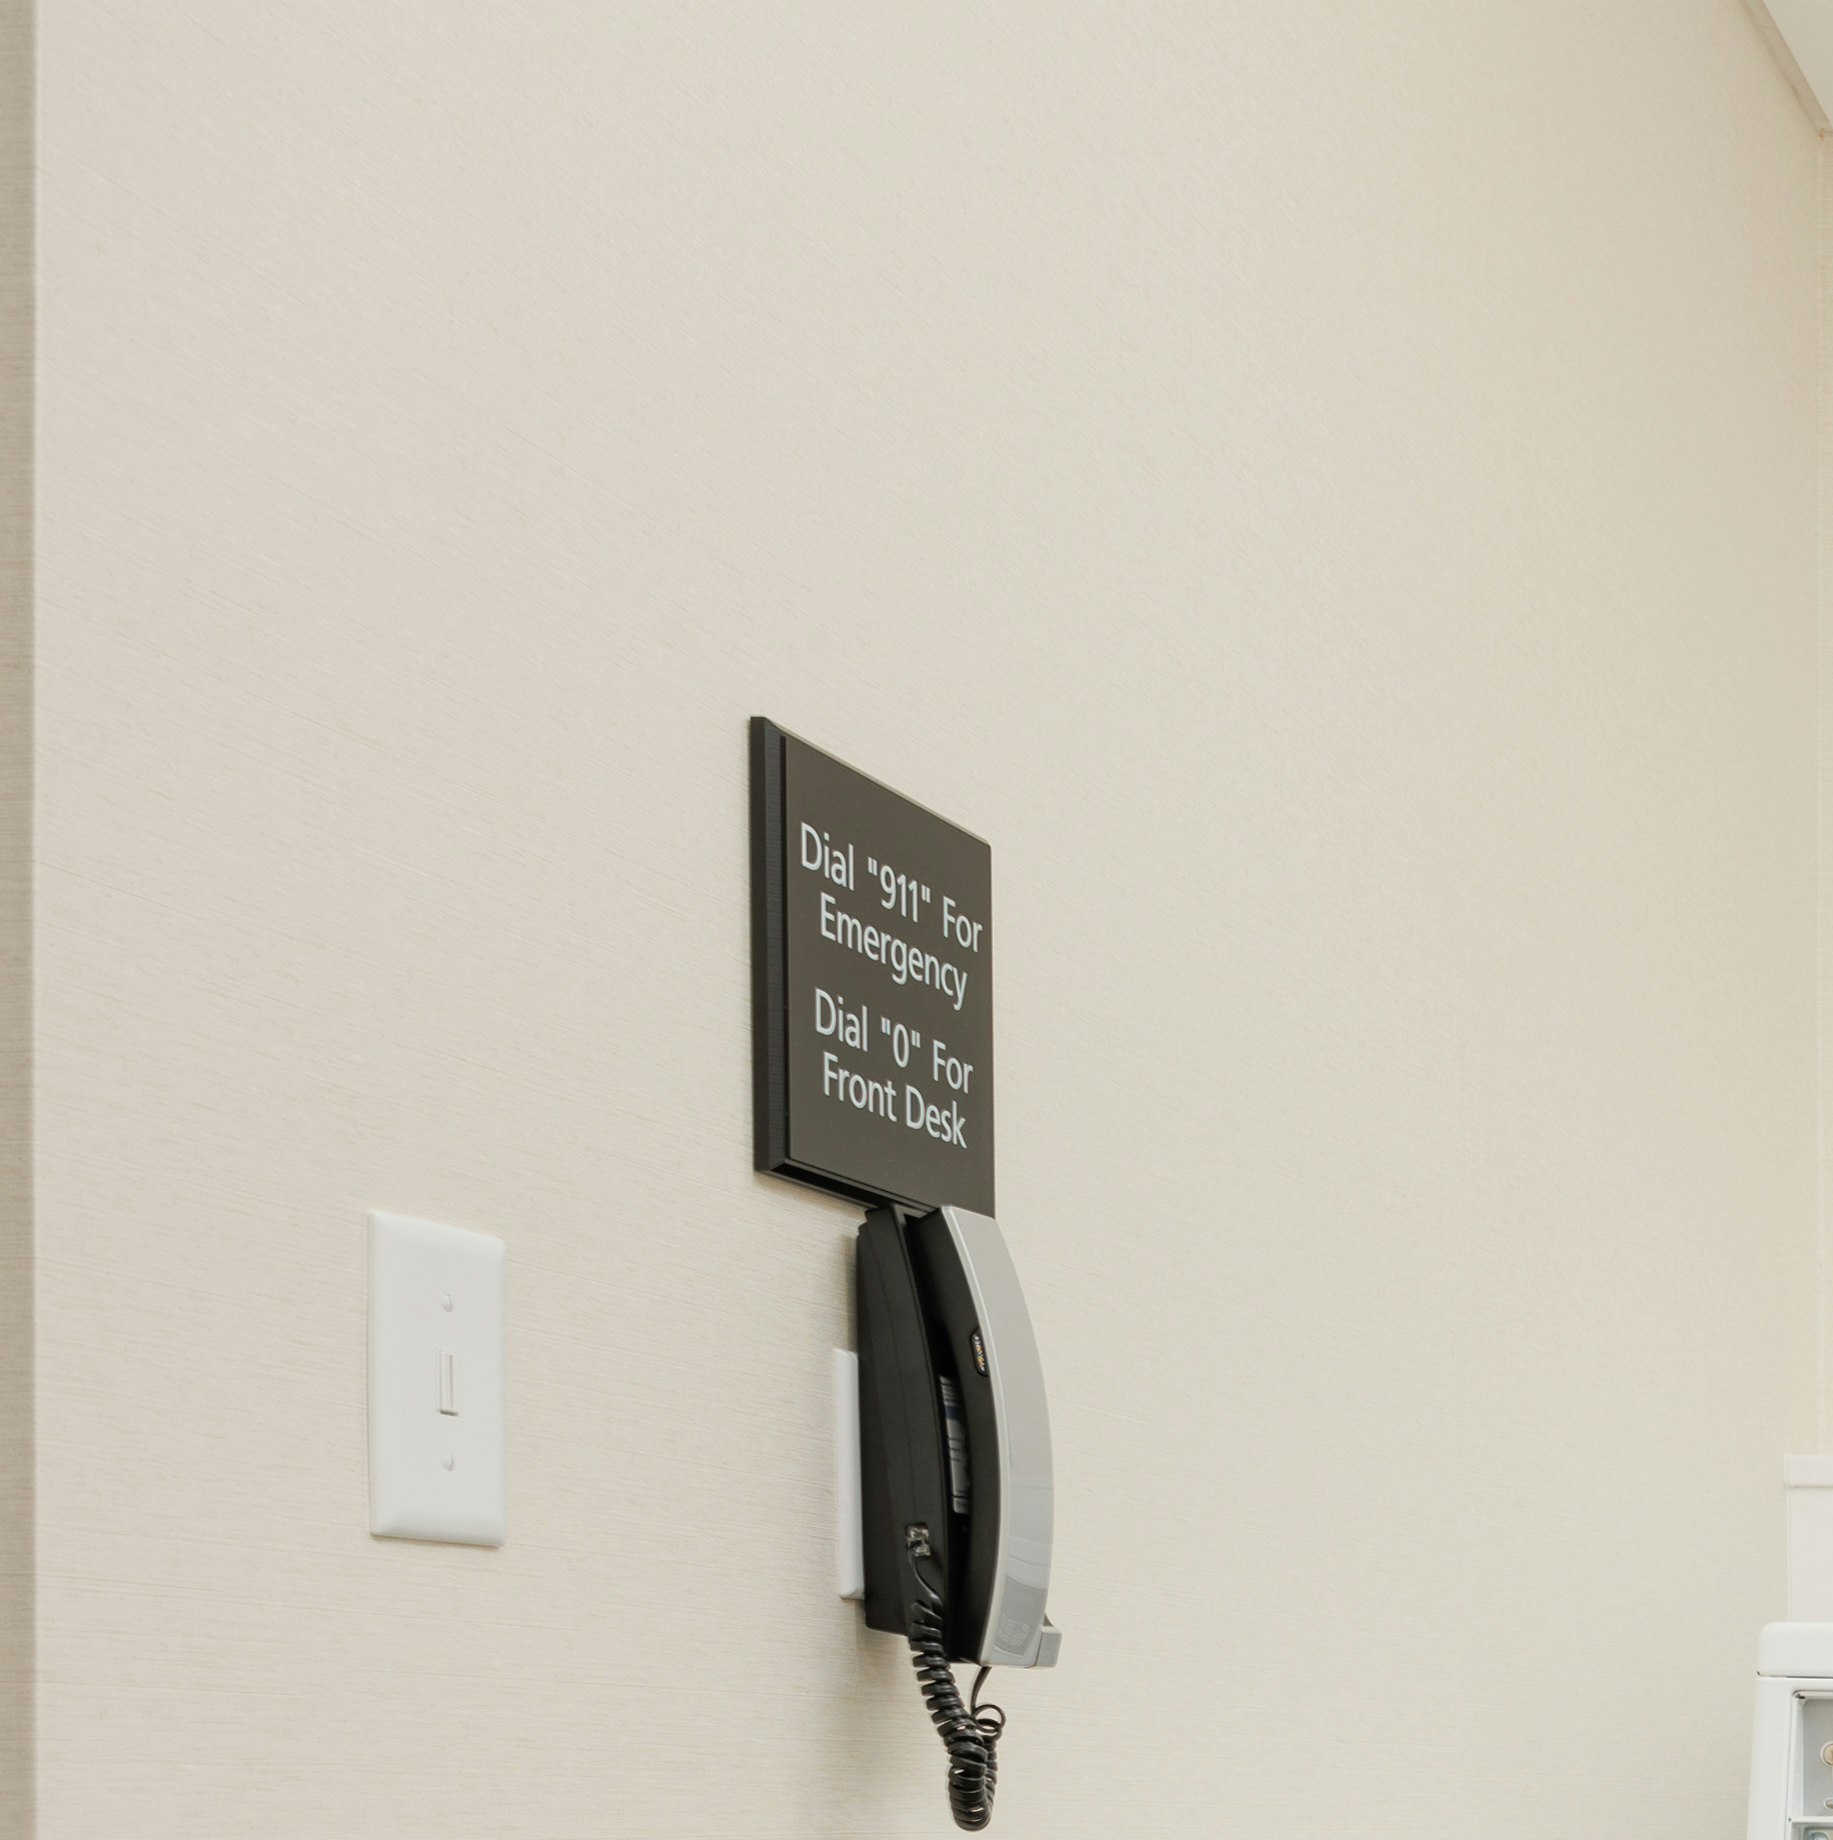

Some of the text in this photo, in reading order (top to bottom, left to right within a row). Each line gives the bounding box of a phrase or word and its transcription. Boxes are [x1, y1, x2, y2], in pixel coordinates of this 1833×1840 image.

[800, 821, 983, 953] Dial "911" For
[820, 891, 968, 1011] Emergency
[815, 987, 974, 1094] Dial "0" For
[823, 1051, 968, 1149] Front Desk
